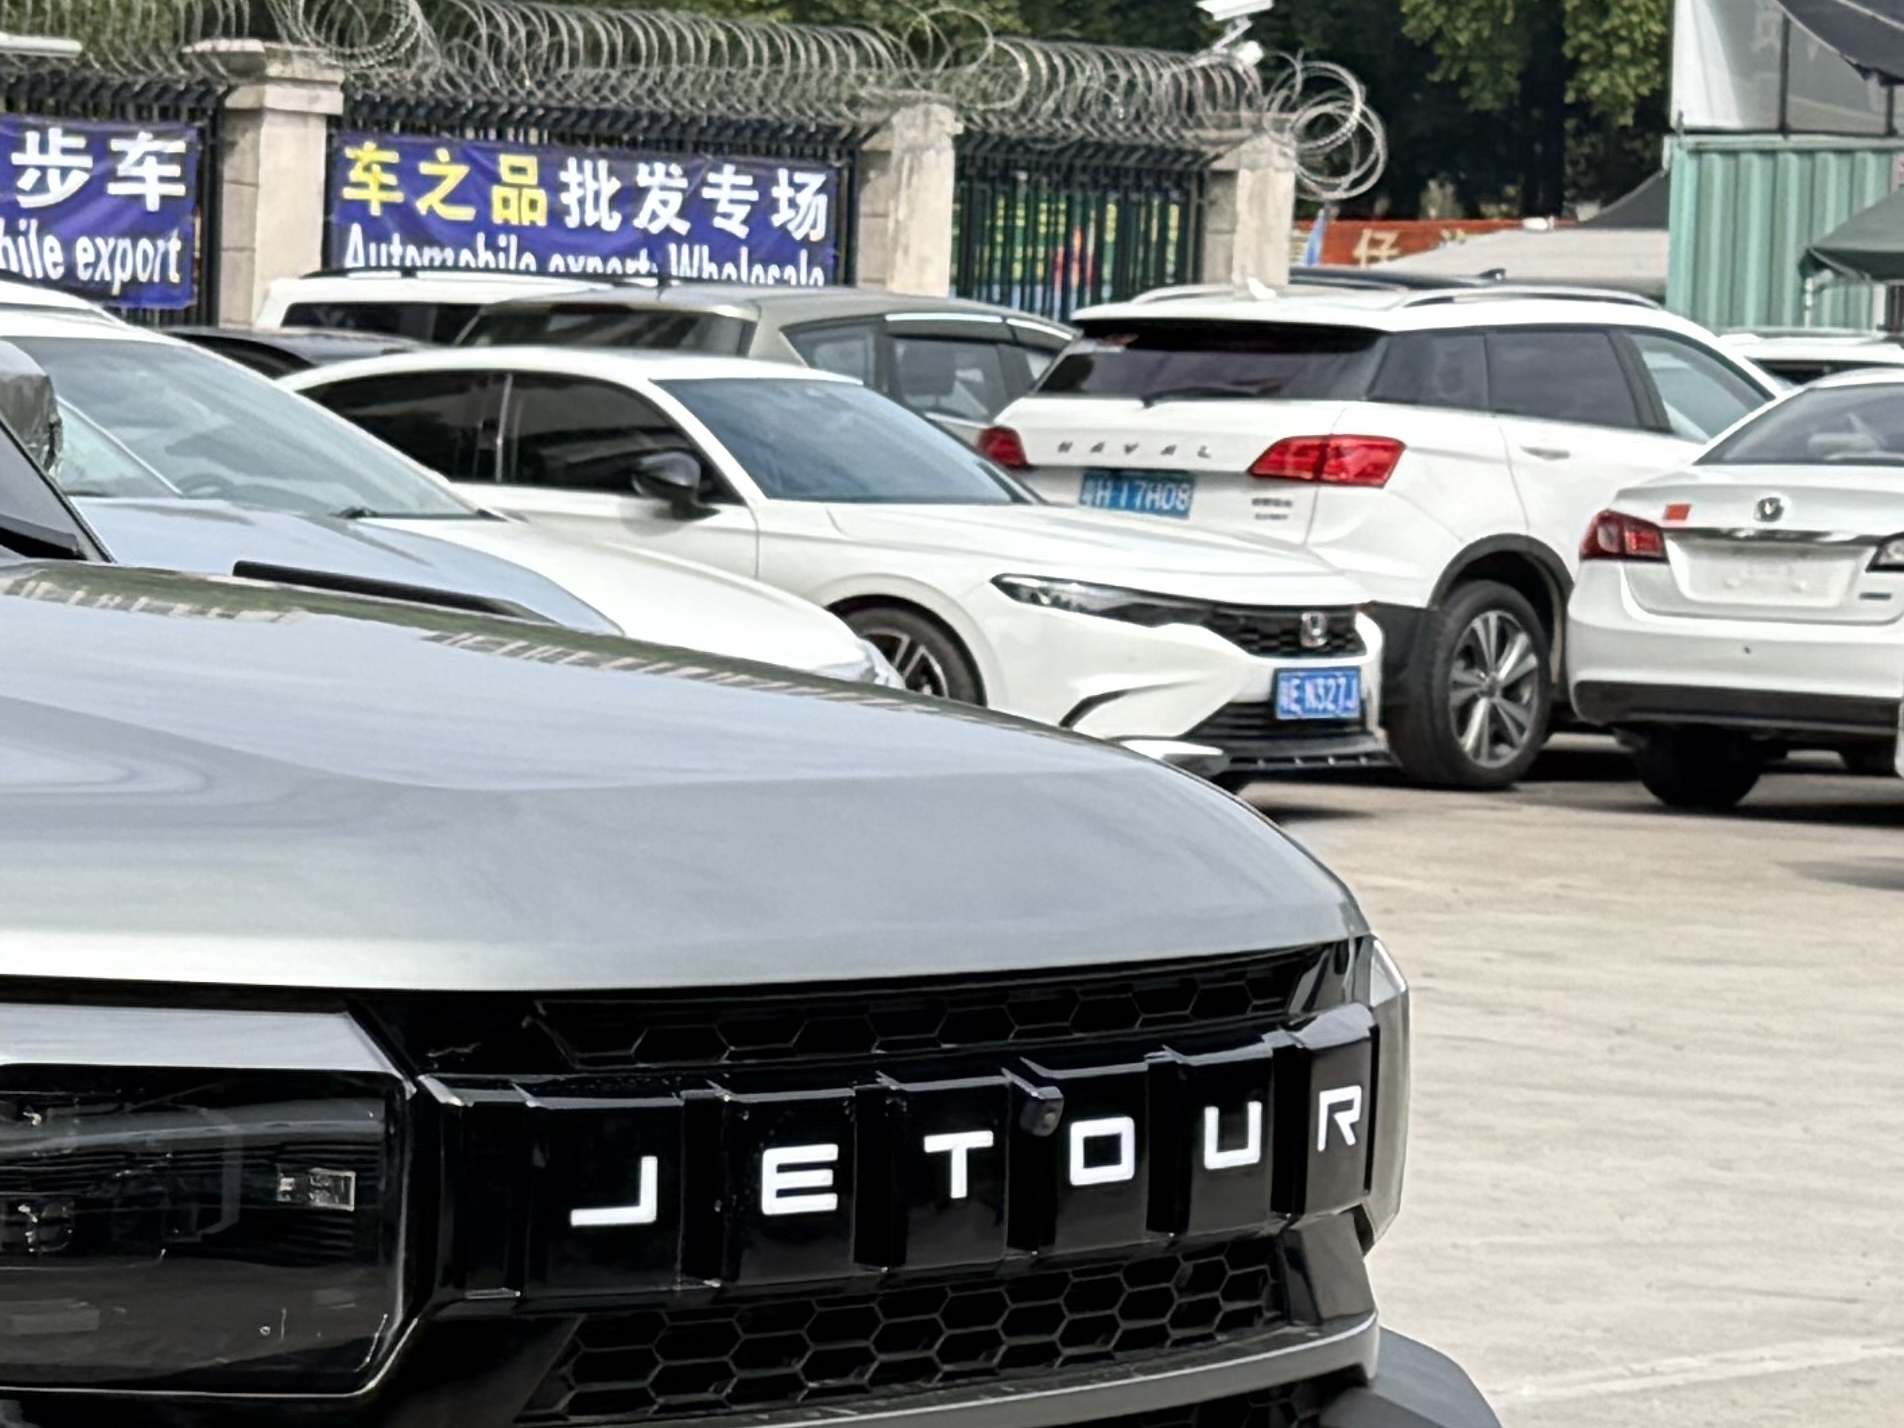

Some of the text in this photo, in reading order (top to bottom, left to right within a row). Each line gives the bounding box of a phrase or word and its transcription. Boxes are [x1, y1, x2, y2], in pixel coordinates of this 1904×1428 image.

[341, 140, 829, 242] 车之品批发专场
[74, 228, 182, 295] export
[1057, 440, 1212, 460] HAVAL
[568, 1083, 1363, 1228] JETOUR
